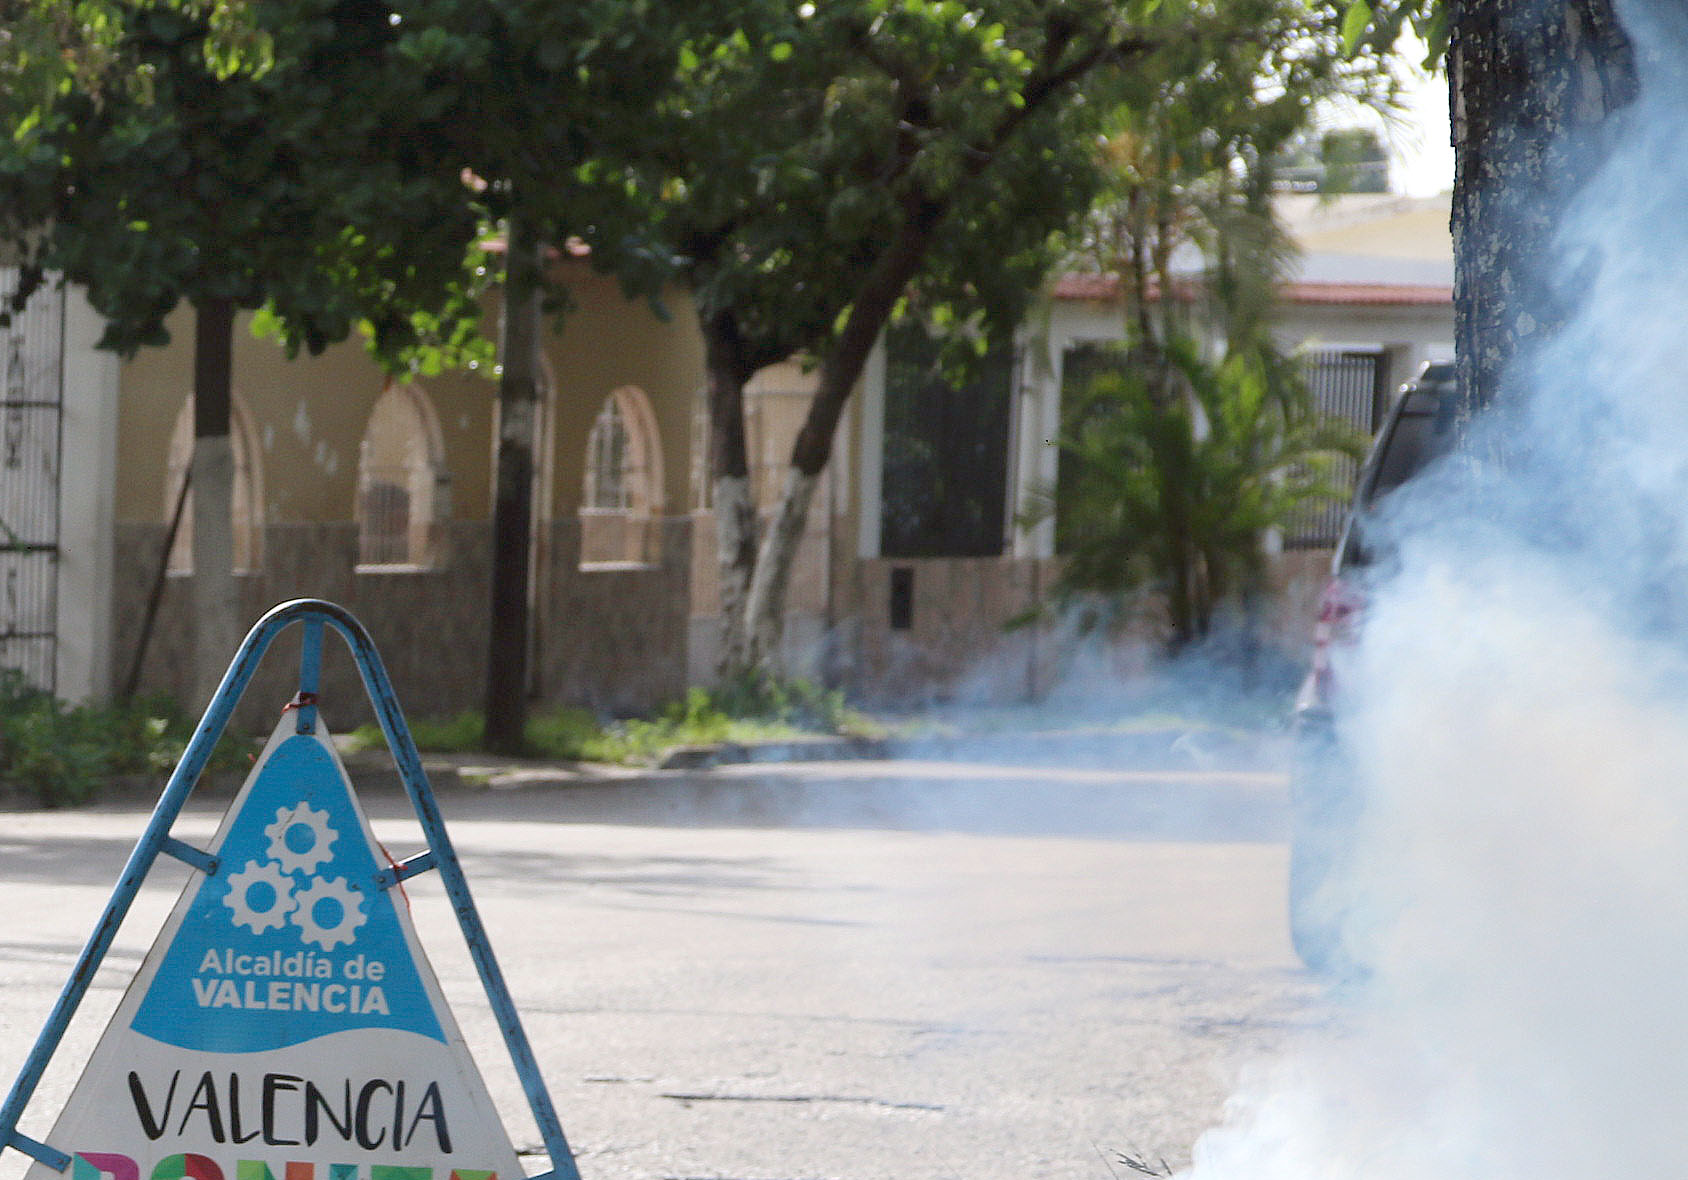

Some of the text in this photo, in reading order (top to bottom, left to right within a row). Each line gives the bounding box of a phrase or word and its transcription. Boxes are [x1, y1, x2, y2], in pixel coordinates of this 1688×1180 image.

[198, 948, 386, 982] Alcaldía de
[191, 977, 391, 1016] VALENCIA
[127, 1069, 453, 1154] VALENCIA
